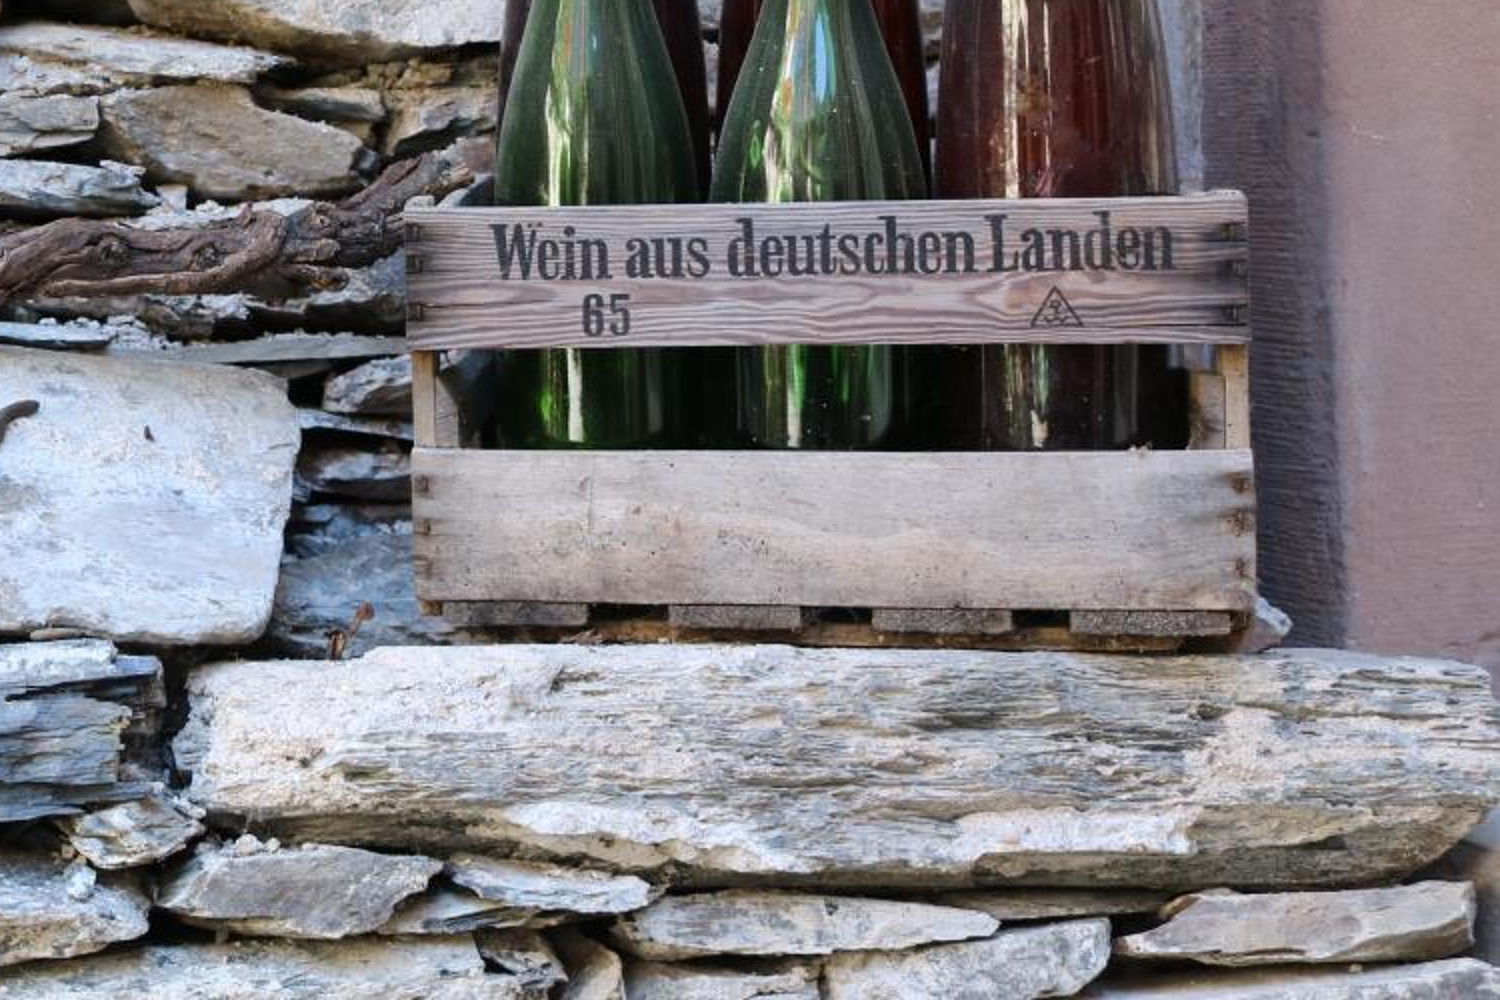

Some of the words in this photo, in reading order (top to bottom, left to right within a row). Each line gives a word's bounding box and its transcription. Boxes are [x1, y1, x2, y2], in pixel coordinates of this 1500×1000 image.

[489, 221, 613, 281] Wein
[625, 236, 711, 279] aus
[727, 216, 979, 277] deutschen
[984, 211, 1178, 272] Landen
[582, 293, 631, 338] 65
